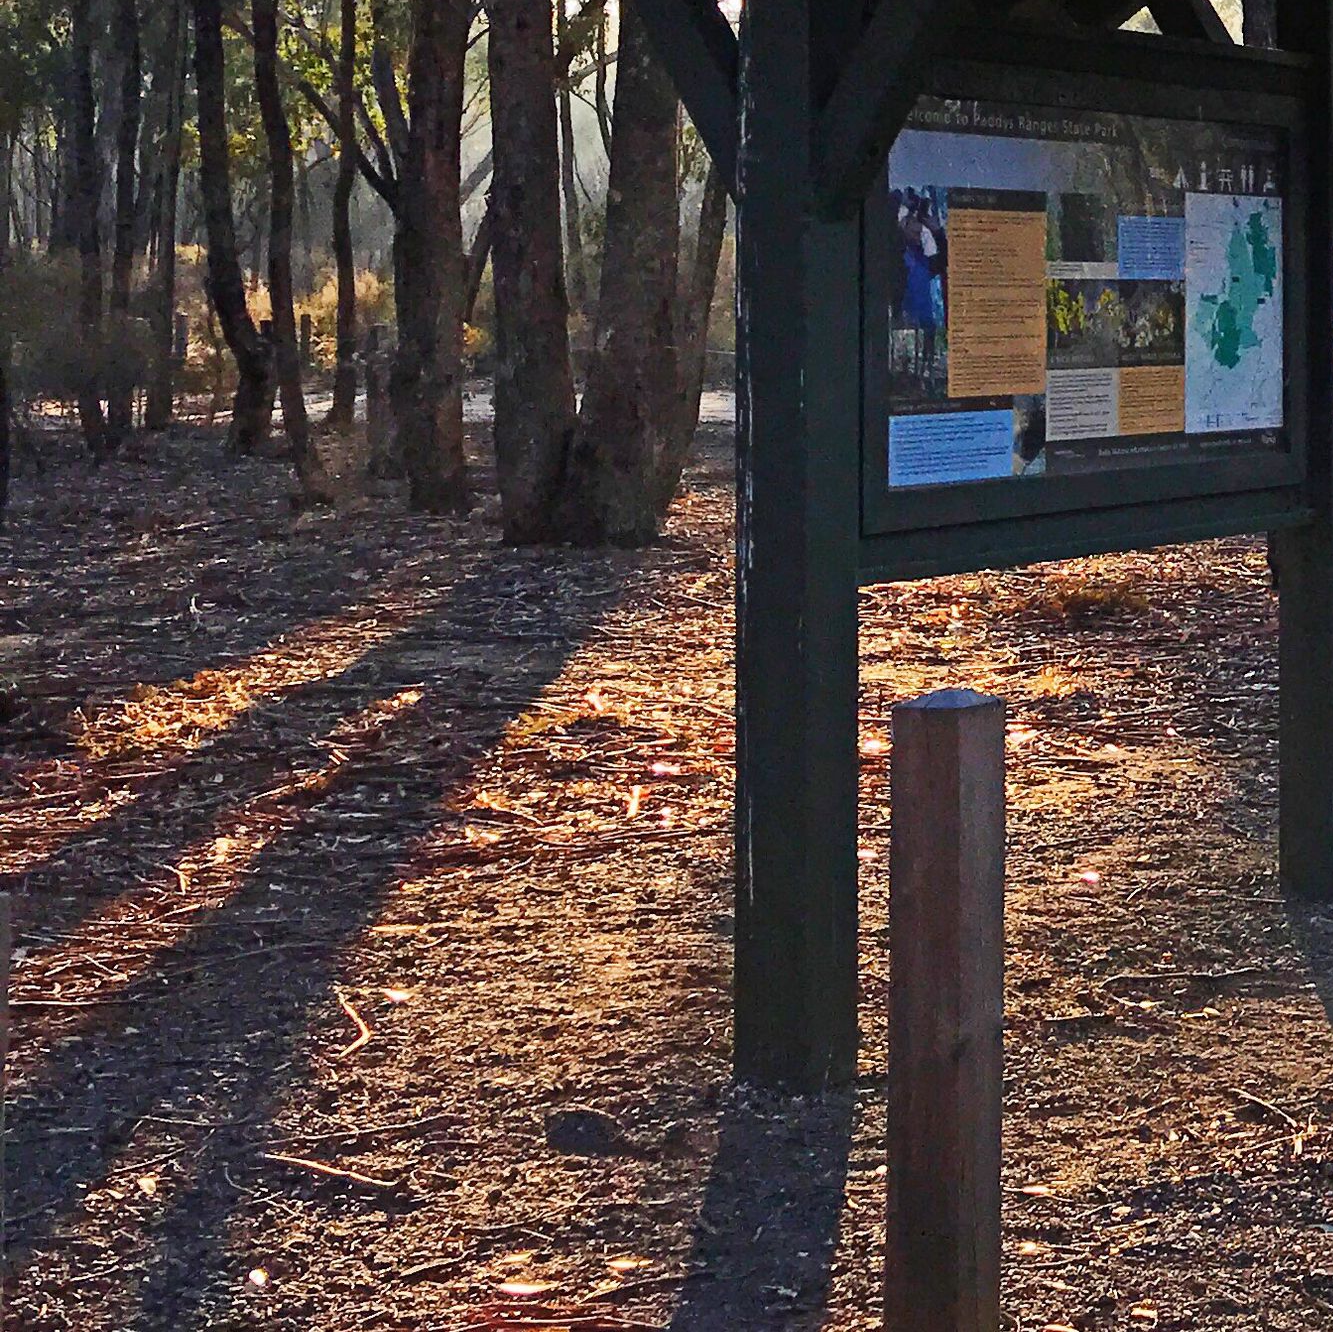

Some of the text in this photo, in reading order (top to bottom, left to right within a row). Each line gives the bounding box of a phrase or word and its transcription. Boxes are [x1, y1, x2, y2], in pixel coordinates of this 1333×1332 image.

[905, 107, 950, 125] elcome
[956, 112, 968, 125] to
[1062, 119, 1090, 135] State
[1094, 122, 1119, 137] Park
